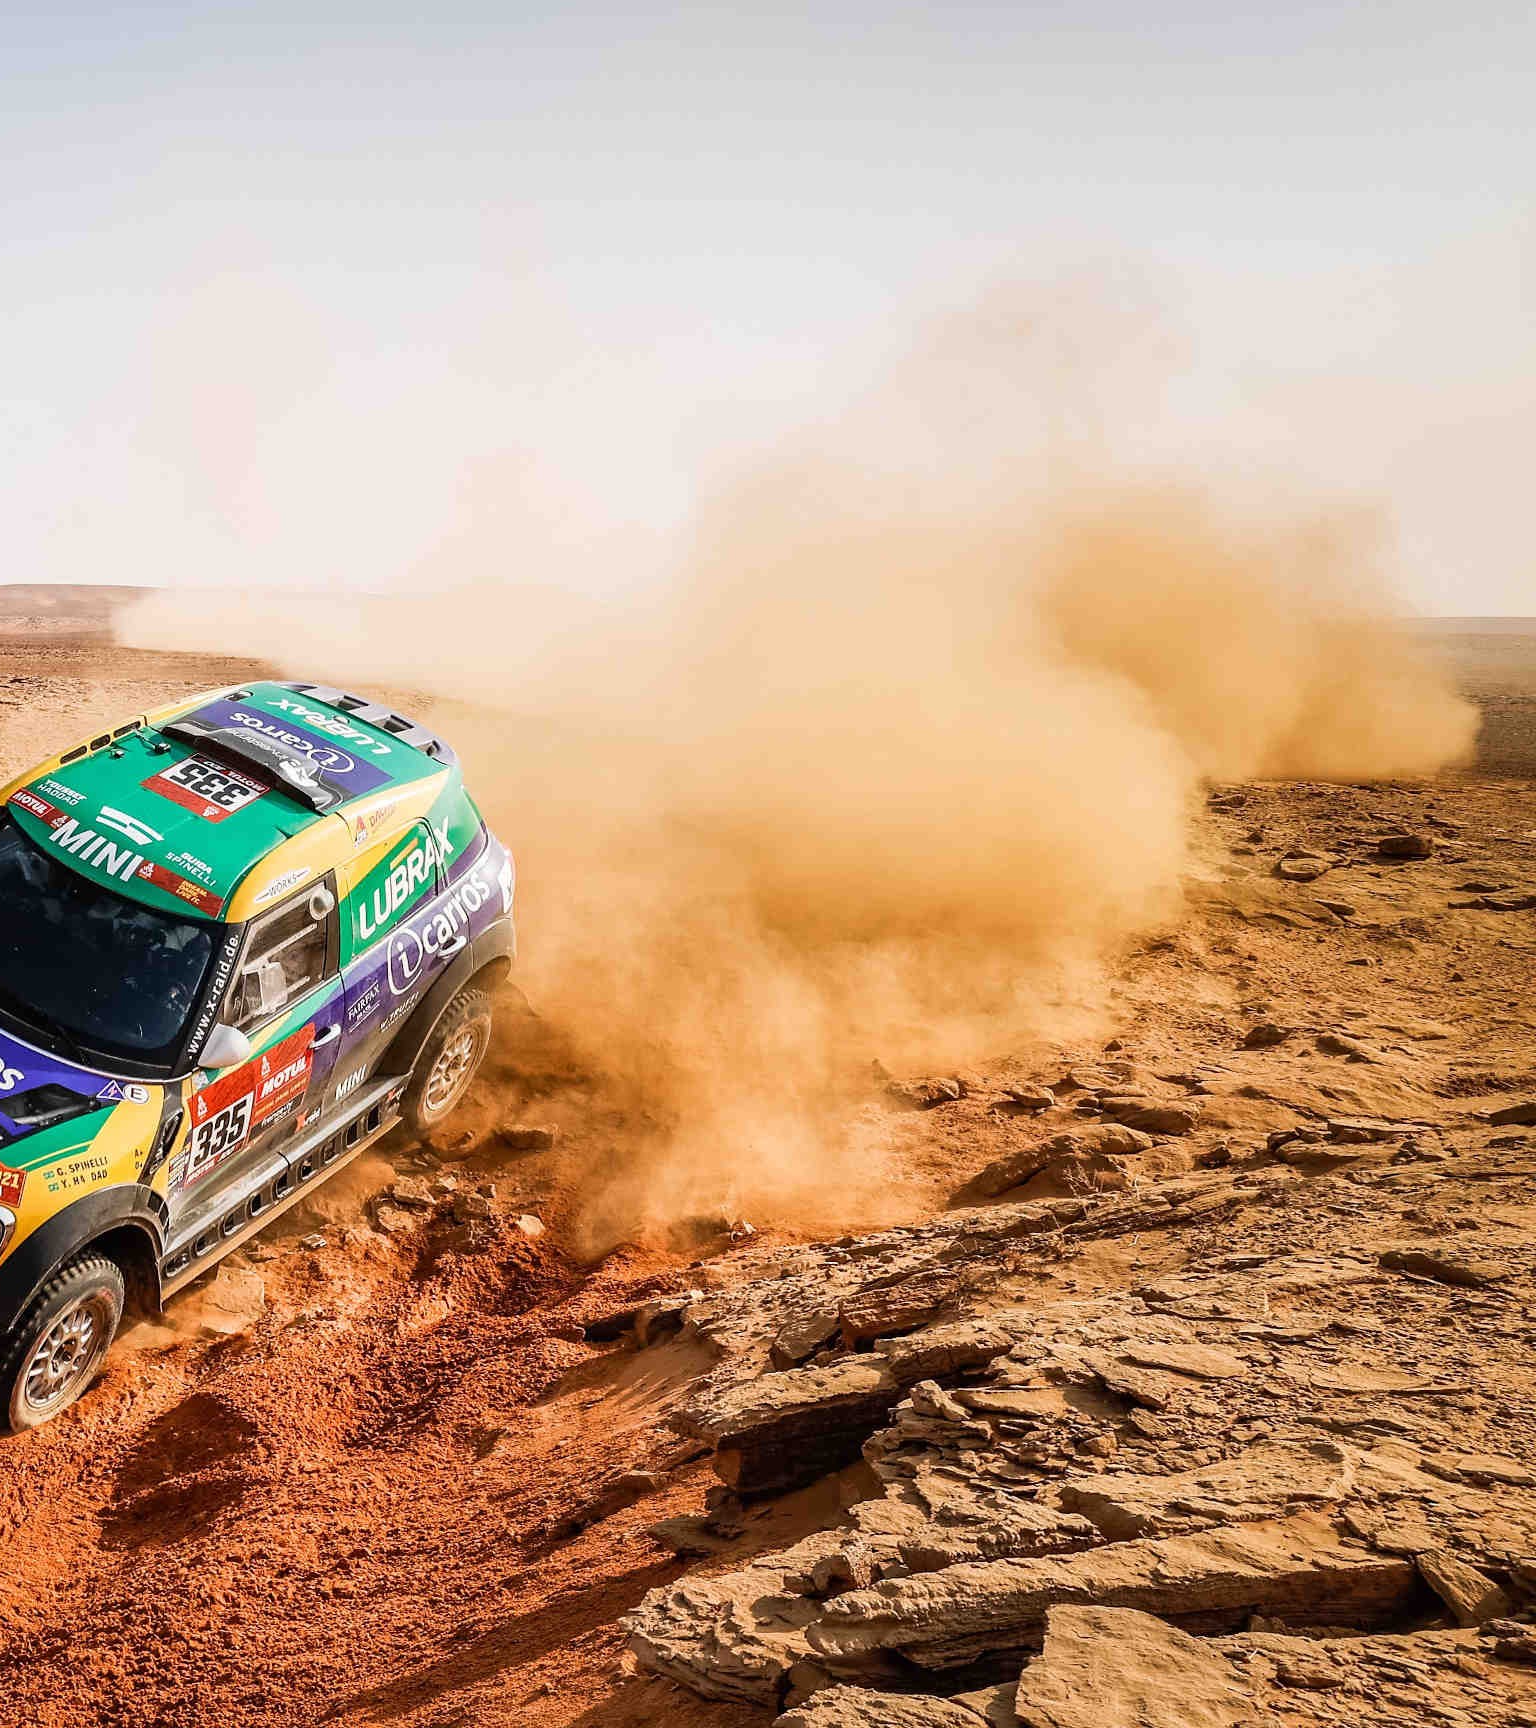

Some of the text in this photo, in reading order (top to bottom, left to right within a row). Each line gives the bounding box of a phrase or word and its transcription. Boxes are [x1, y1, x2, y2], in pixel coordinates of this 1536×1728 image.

[265, 699, 392, 755] LUBRAX
[12, 791, 48, 814] MOTUL
[169, 763, 250, 806] 335
[49, 818, 144, 882] MINI
[165, 852, 217, 887] SPINELLI
[268, 873, 297, 897] WORKS
[359, 817, 455, 940] LUBRAX
[348, 984, 380, 1021] FAIRFAX
[261, 1060, 307, 1098] MOTUL
[335, 1064, 367, 1100] MINI
[194, 1100, 247, 1168] 335
[68, 1156, 109, 1174] SPINELLI
